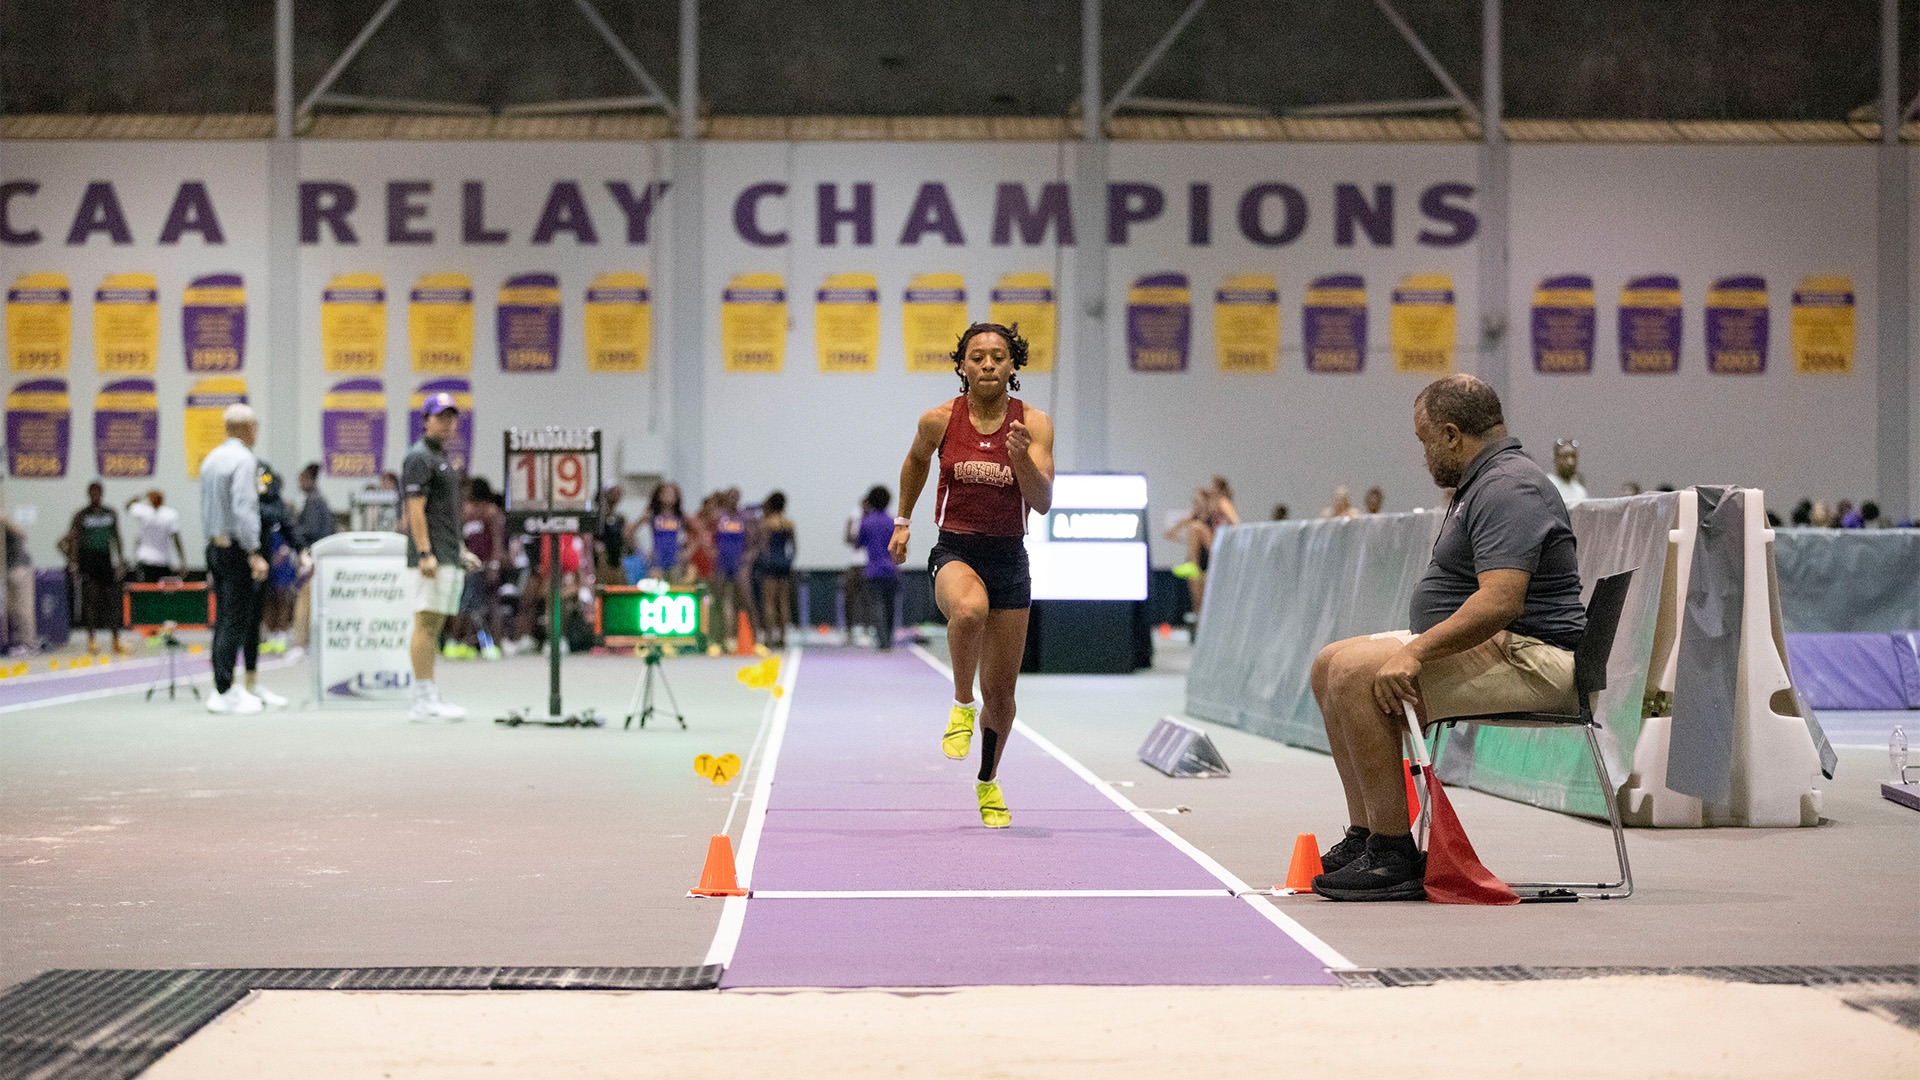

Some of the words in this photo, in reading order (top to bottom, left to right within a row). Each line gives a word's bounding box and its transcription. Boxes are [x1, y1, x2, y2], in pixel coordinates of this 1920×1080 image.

[298, 180, 672, 246] RELAY
[731, 181, 1484, 247] CHAMPIONS
[954, 461, 1014, 485] LOYOLA
[335, 570, 400, 585] Runway
[329, 586, 406, 601] Markings
[328, 618, 361, 632] TAPE
[369, 618, 411, 632] ONLY
[328, 635, 350, 649] NO
[356, 635, 406, 649] CHALK
[357, 670, 412, 690] LSU
